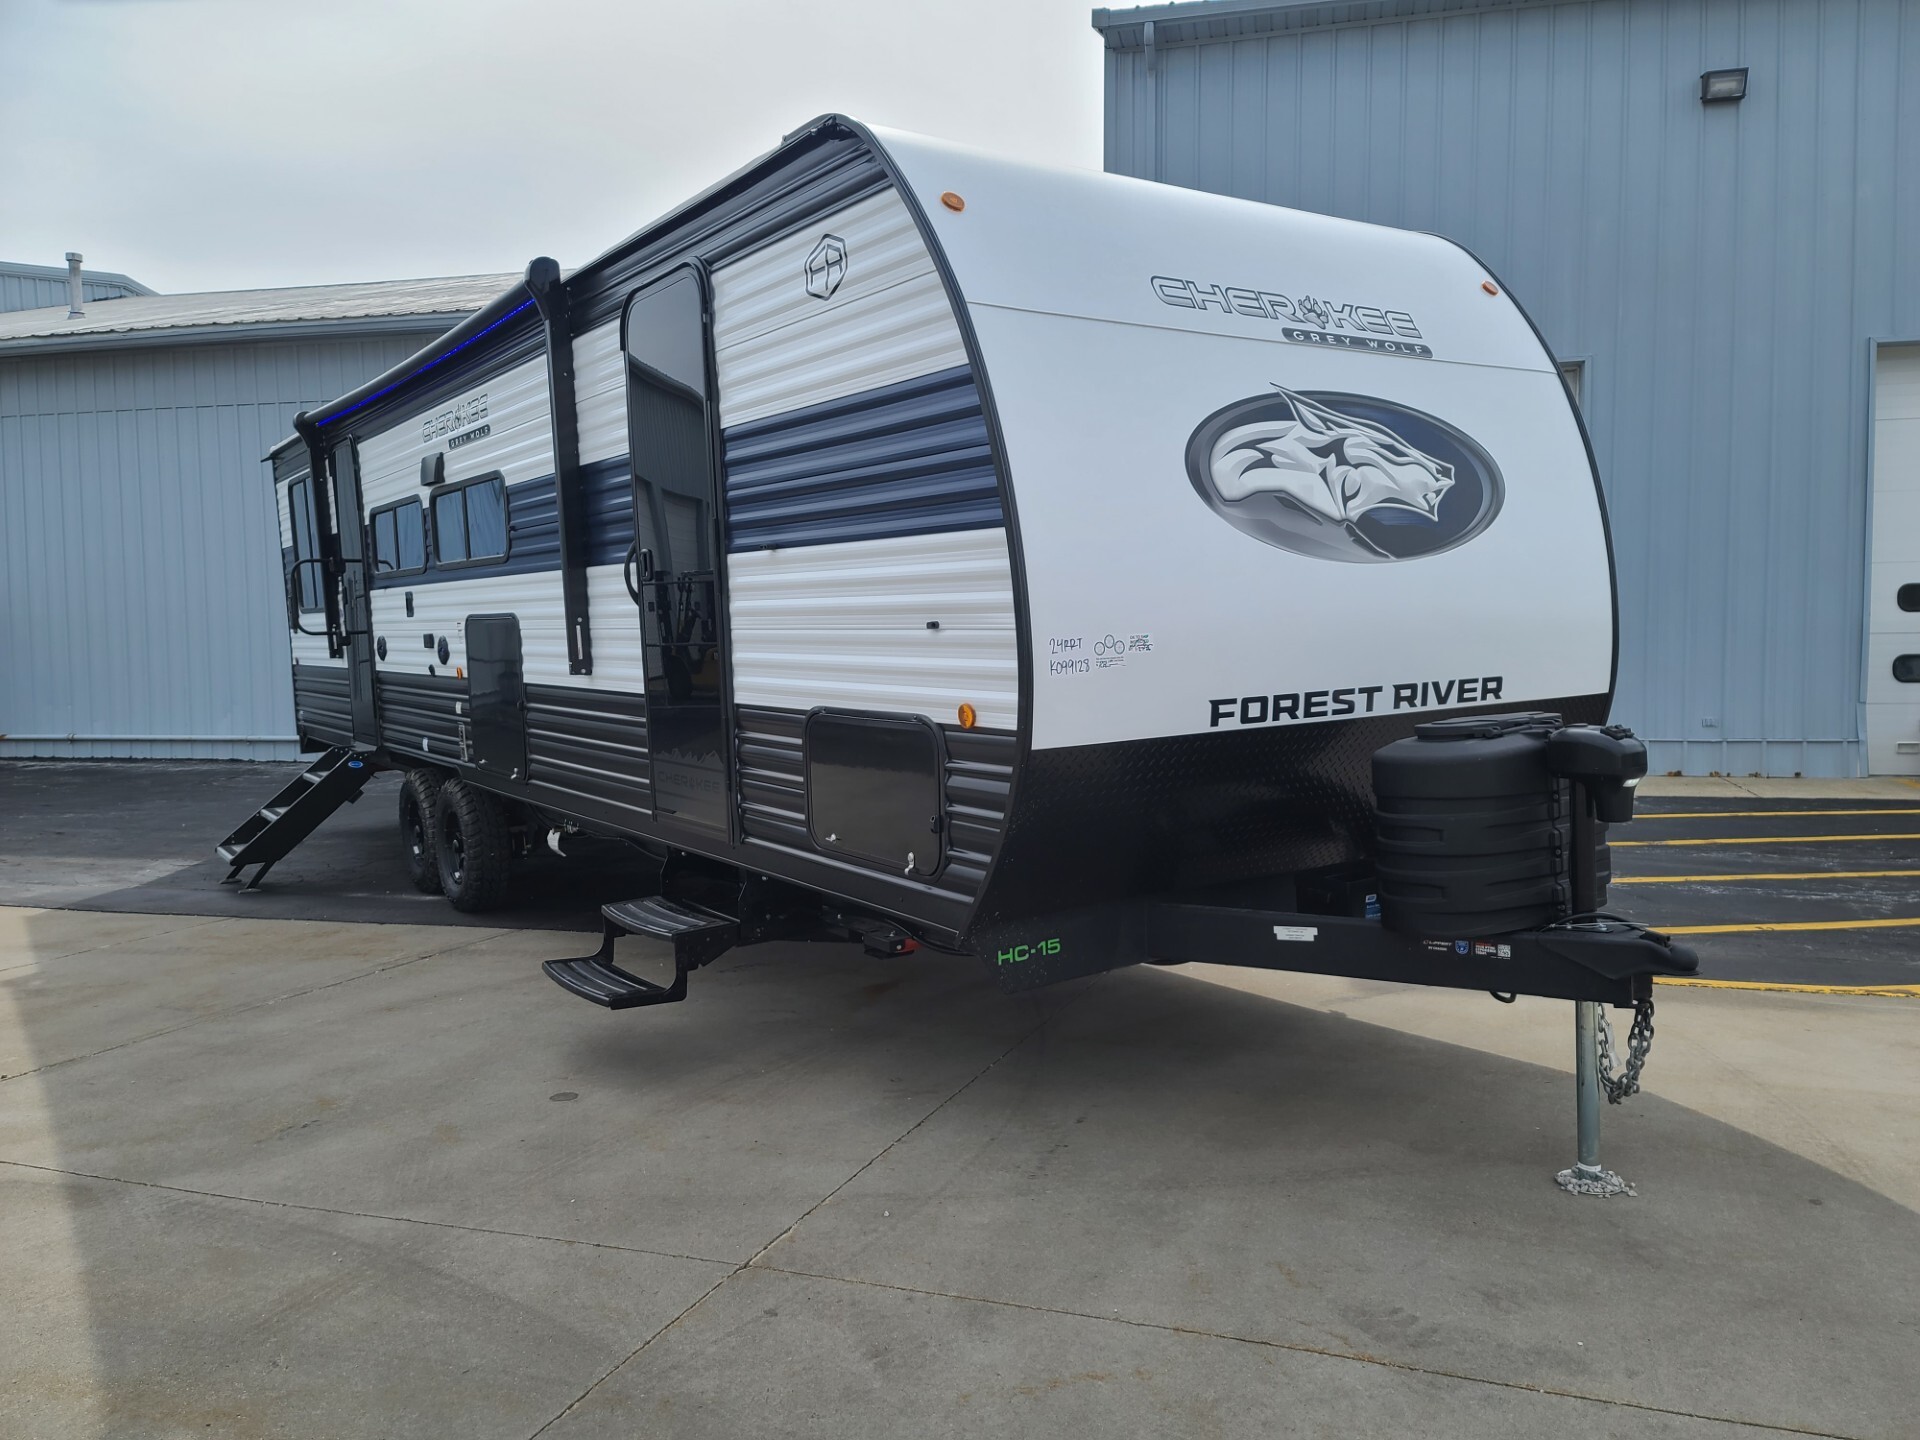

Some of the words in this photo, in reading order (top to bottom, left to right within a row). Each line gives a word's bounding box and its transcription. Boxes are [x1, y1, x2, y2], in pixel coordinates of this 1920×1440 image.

[1292, 330, 1351, 346] GREY
[1366, 338, 1423, 355] WOLF
[450, 436, 467, 448] GREY
[469, 426, 489, 439] WOLF
[1208, 685, 1383, 728] FOREST
[1392, 675, 1503, 709] RIVER
[997, 938, 1061, 966] HC-15
